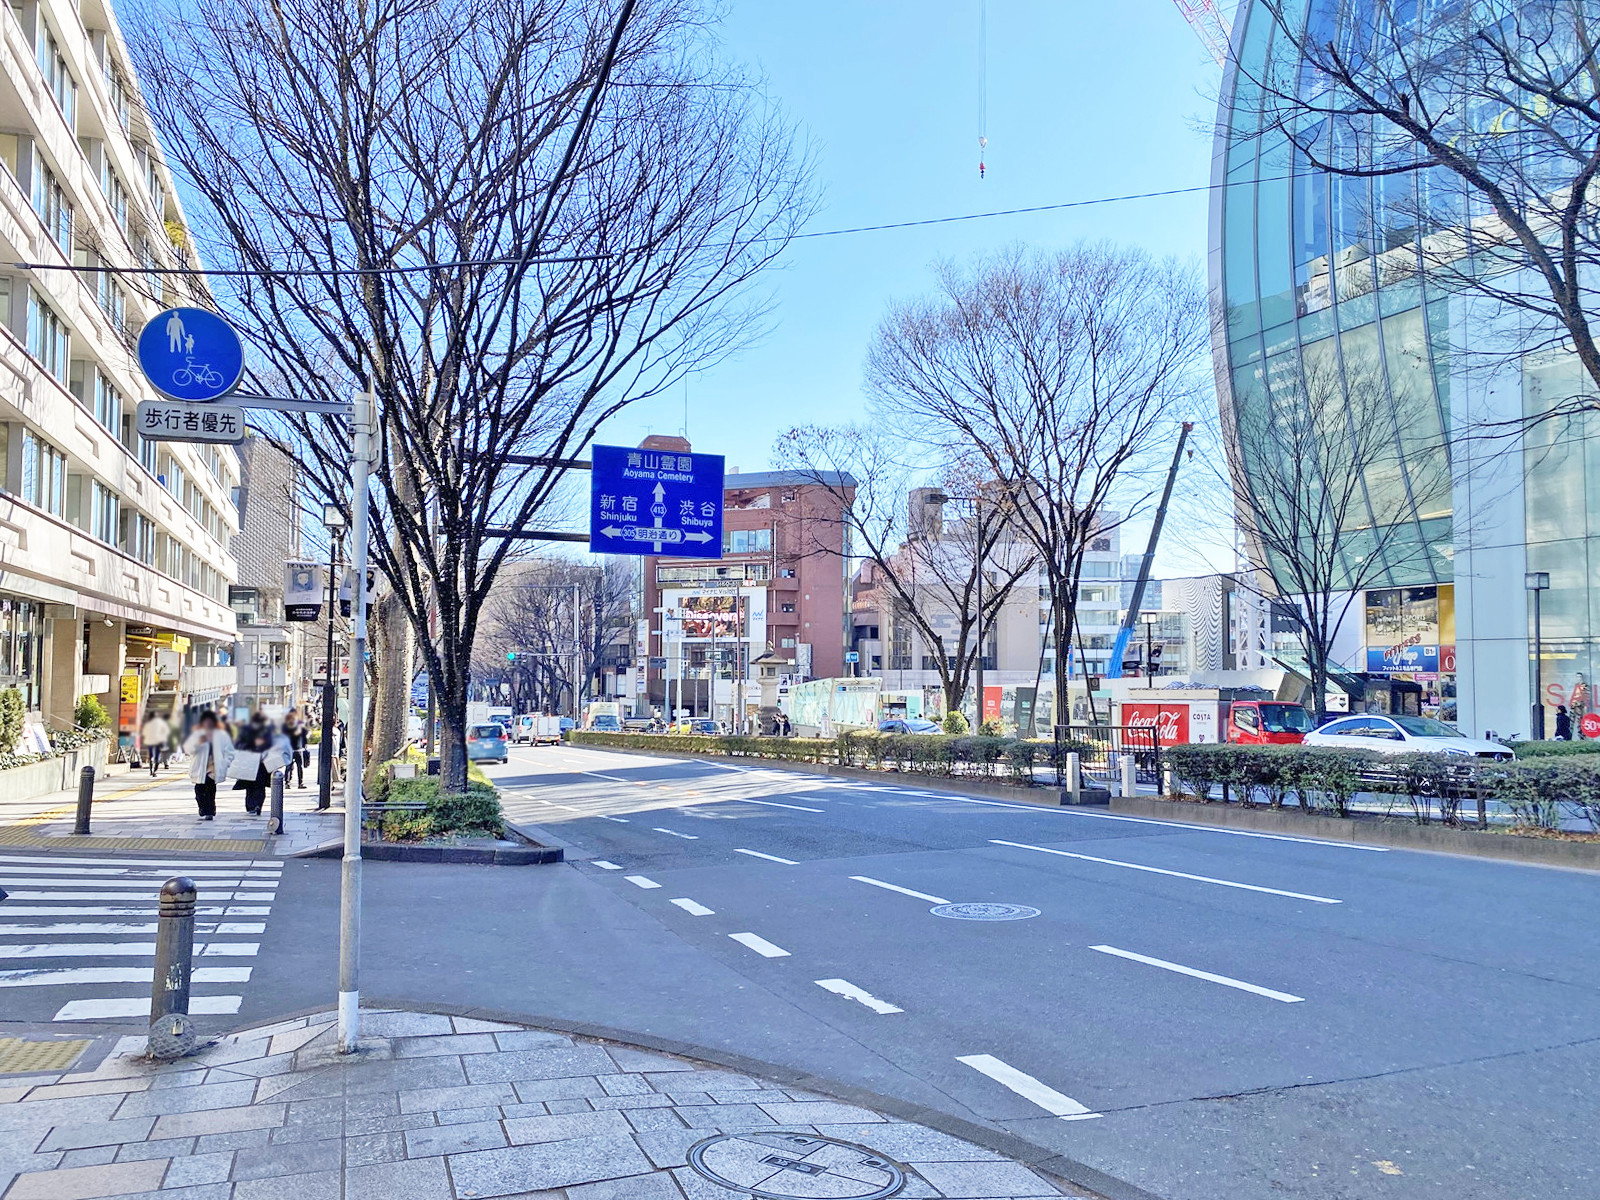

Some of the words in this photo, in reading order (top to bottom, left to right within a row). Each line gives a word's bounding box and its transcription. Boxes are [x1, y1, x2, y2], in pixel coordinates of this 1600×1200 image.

[145, 408, 236, 434] 歩行者優先
[627, 452, 692, 472] 青山霊園
[623, 468, 655, 479] Aoyama
[657, 471, 694, 482] Cemetery
[599, 493, 639, 512] 新宿
[679, 499, 716, 517] 渋谷
[600, 511, 637, 522] Shinjuku
[652, 505, 666, 515] 413
[681, 516, 714, 527] Shibuya
[623, 528, 636, 538] 305
[637, 529, 679, 541] 明治通り
[1192, 713, 1211, 721] COSTA
[1128, 710, 1181, 740] Coca-Cola
